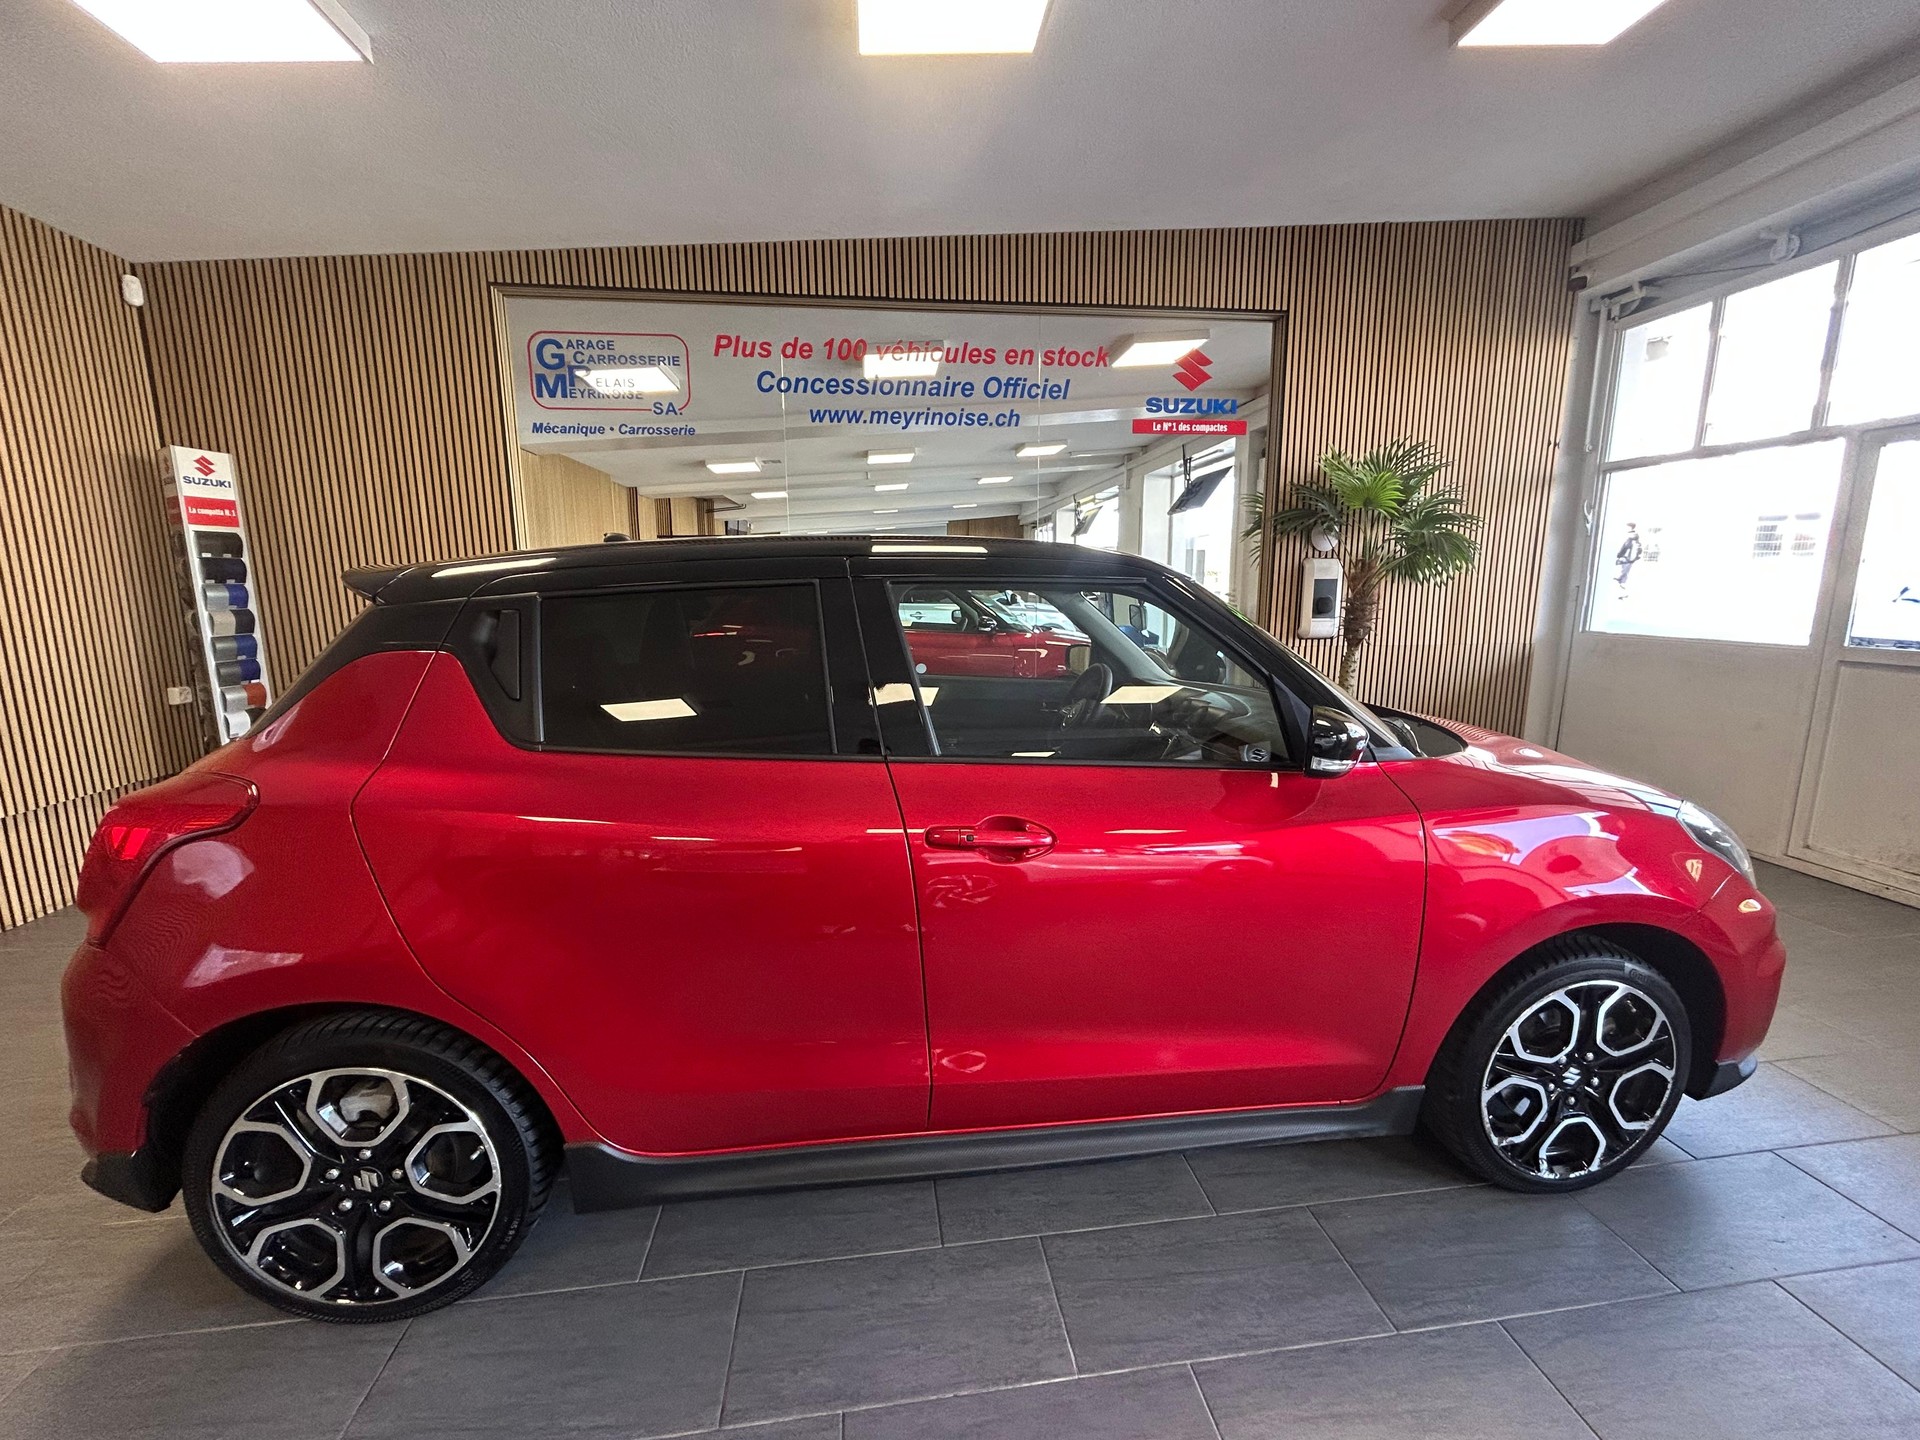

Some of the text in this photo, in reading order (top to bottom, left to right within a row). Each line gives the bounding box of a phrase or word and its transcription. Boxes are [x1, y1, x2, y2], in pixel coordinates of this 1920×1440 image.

[572, 351, 681, 367] CARROSSERIE
[713, 334, 1112, 368] Plus de 100 véhicules en stock
[756, 370, 1071, 400] Concessionnaire Officiel
[1145, 397, 1237, 414] SUZUKI
[809, 407, 1021, 430] www.meyrinoise.ch
[531, 422, 696, 437] Mécanique Carrosserie
[1152, 421, 1162, 431] Le
[1178, 422, 1191, 432] des
[1191, 424, 1228, 434] compactes
[183, 476, 231, 488] SUZUKI
